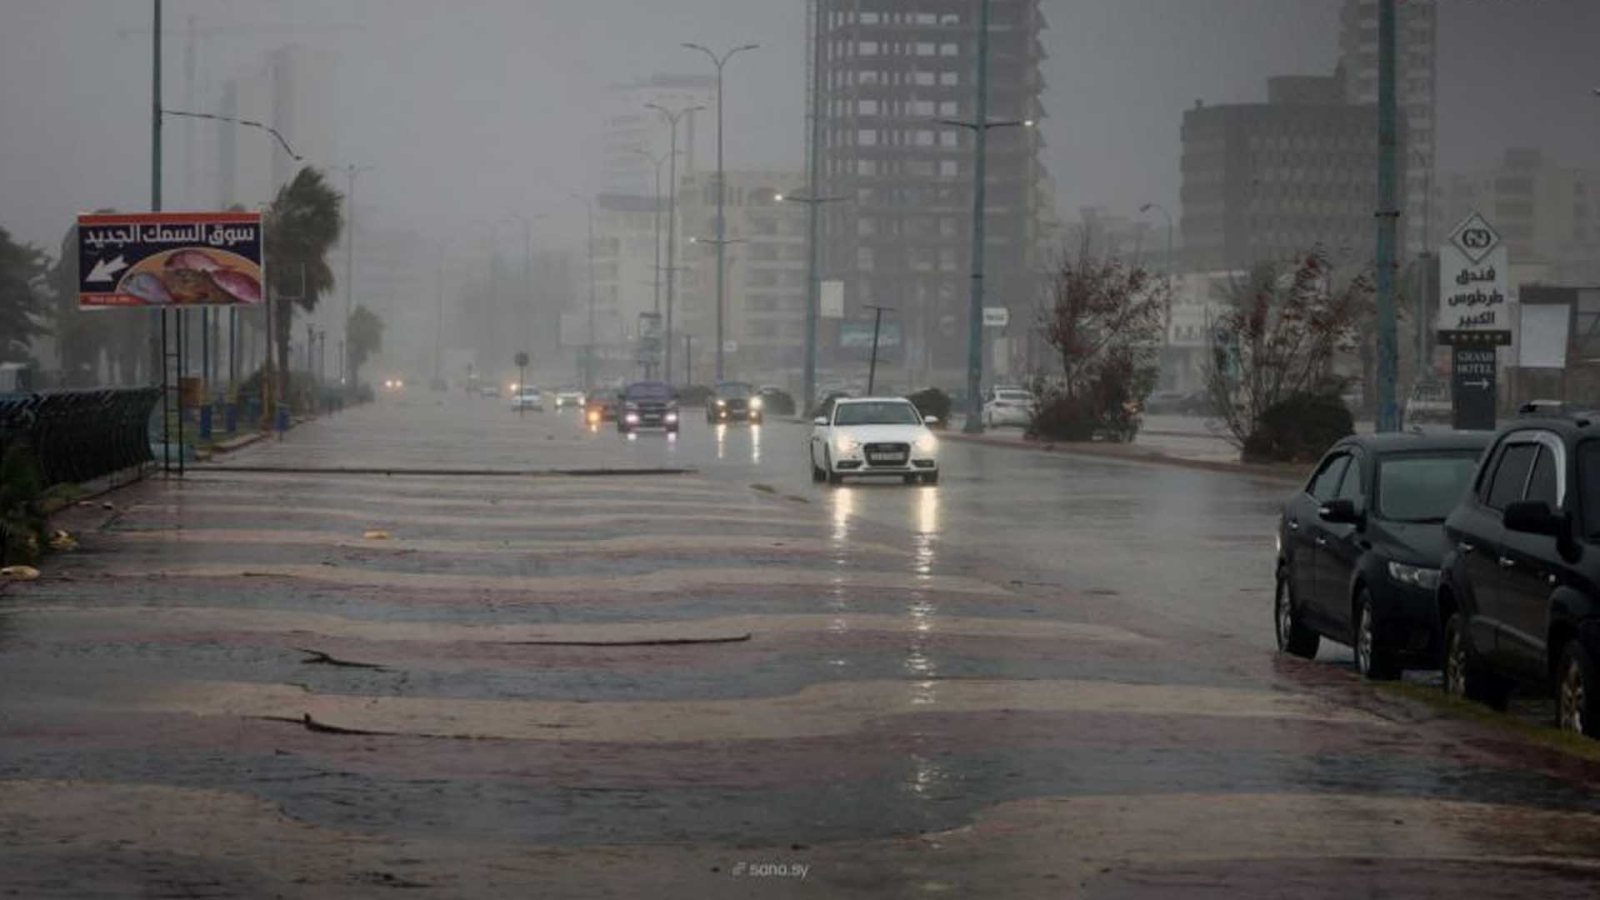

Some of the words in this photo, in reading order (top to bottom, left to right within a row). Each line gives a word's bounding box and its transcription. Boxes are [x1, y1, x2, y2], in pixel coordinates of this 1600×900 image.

[85, 223, 140, 247] الجديد
[143, 223, 205, 243] السمك
[209, 224, 254, 245] سوق
[1456, 266, 1495, 285] فندق
[1448, 288, 1504, 306] طرطوس
[1459, 311, 1495, 327] الكبير
